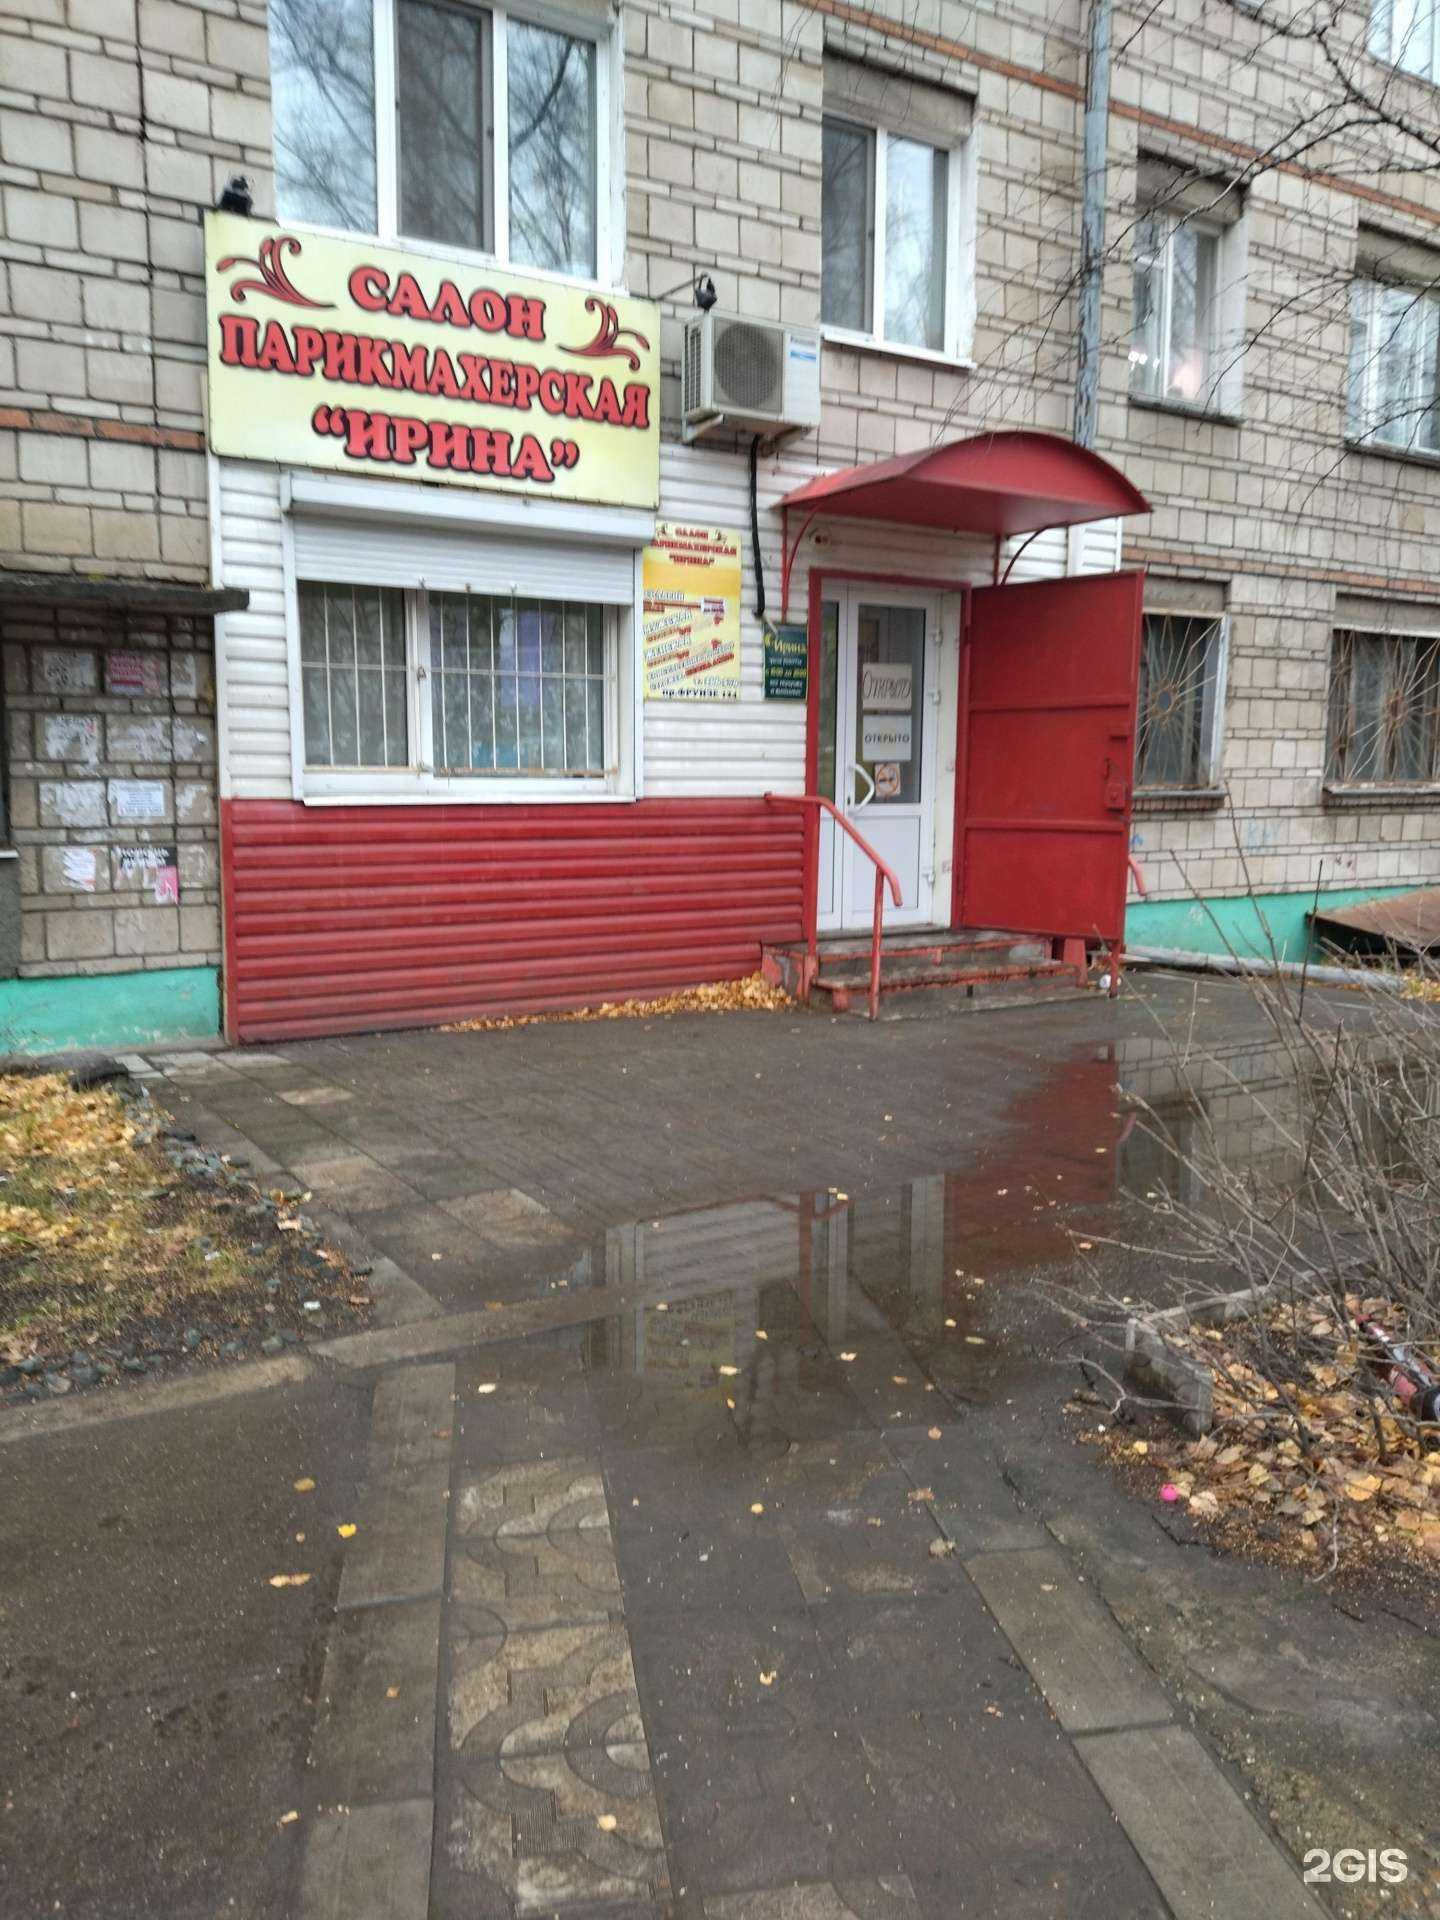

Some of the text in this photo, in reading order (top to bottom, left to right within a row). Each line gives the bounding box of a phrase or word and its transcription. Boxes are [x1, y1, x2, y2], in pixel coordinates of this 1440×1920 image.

[349, 265, 546, 341] САЛОН
[218, 313, 651, 429] ПАРИКМАХЕРСКАЯ
[864, 733, 910, 743] ОТКРЫТО
